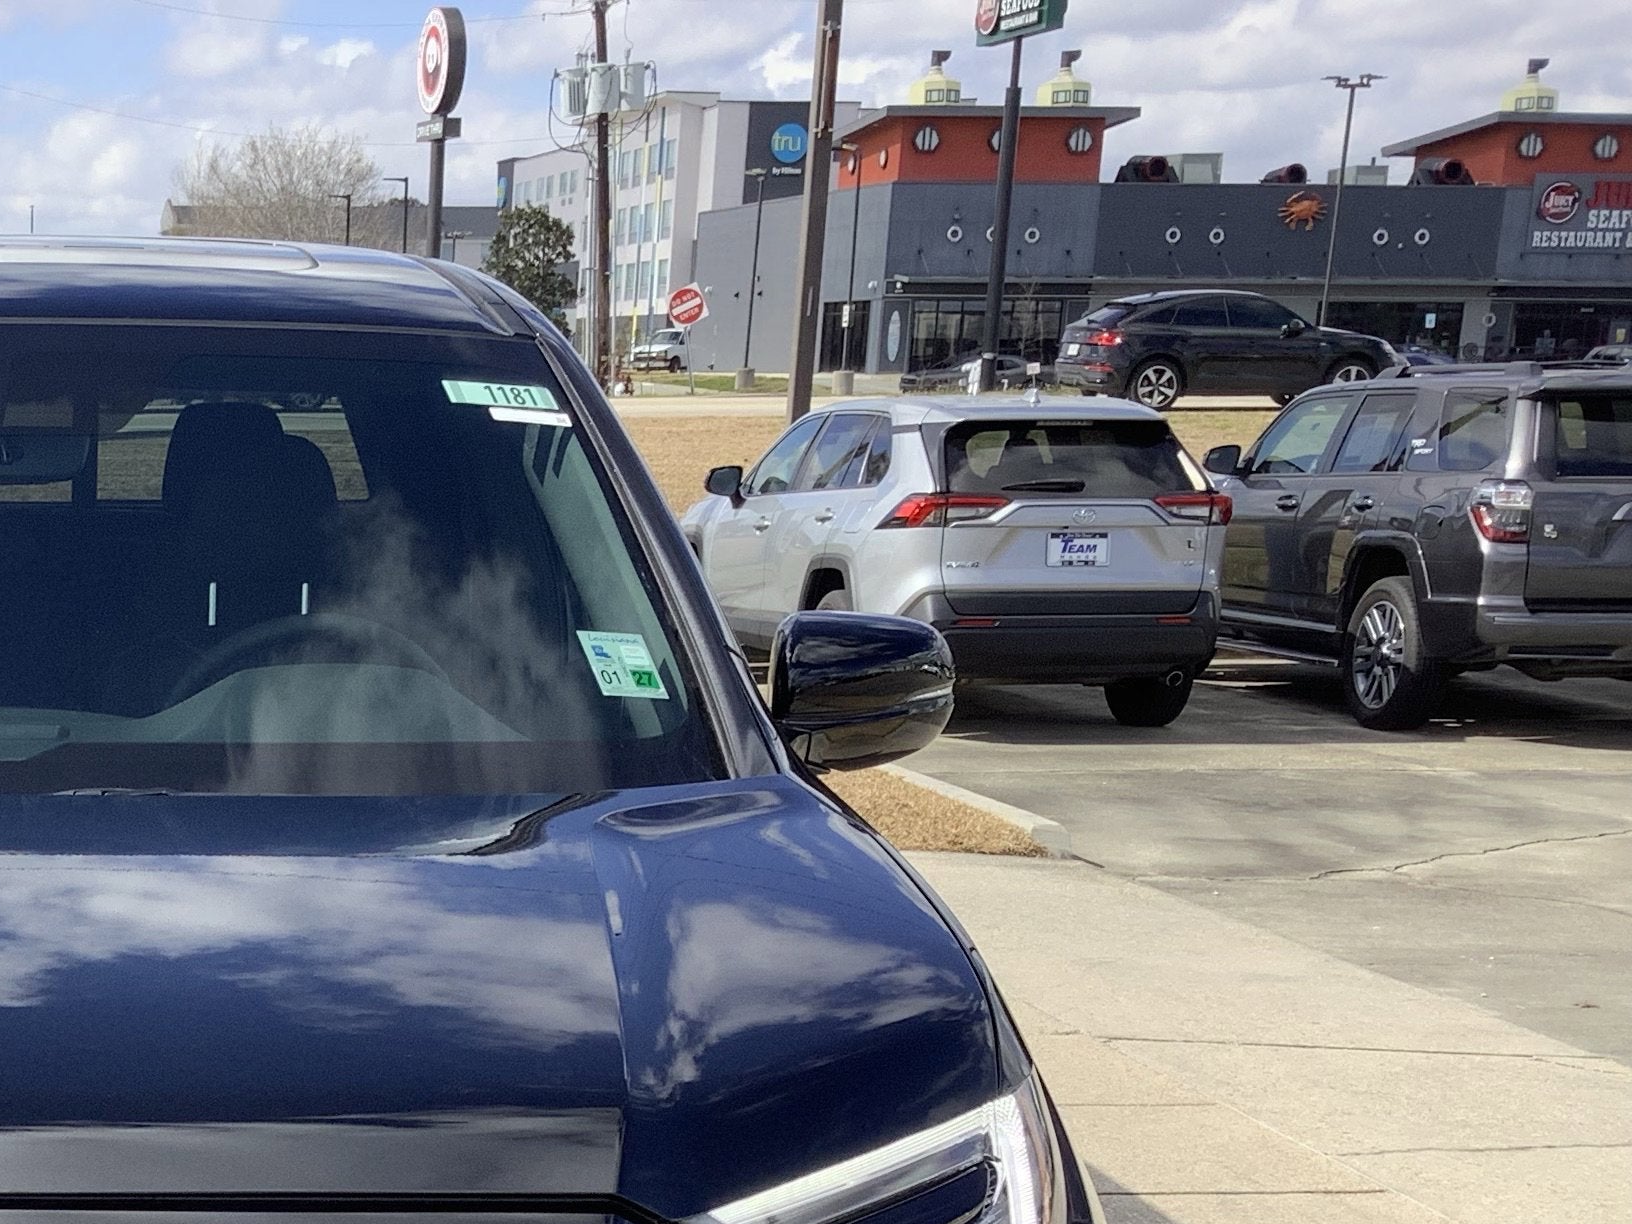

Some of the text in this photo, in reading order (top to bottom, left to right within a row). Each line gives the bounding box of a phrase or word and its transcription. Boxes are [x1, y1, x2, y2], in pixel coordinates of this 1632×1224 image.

[772, 131, 801, 152] tru
[1587, 209, 1632, 229] SEAF
[1532, 231, 1622, 247] RESTAURANT
[671, 291, 696, 308] DO NOT
[679, 307, 700, 321] ENTER
[483, 385, 539, 406] 1181
[600, 669, 654, 687] 01 27
